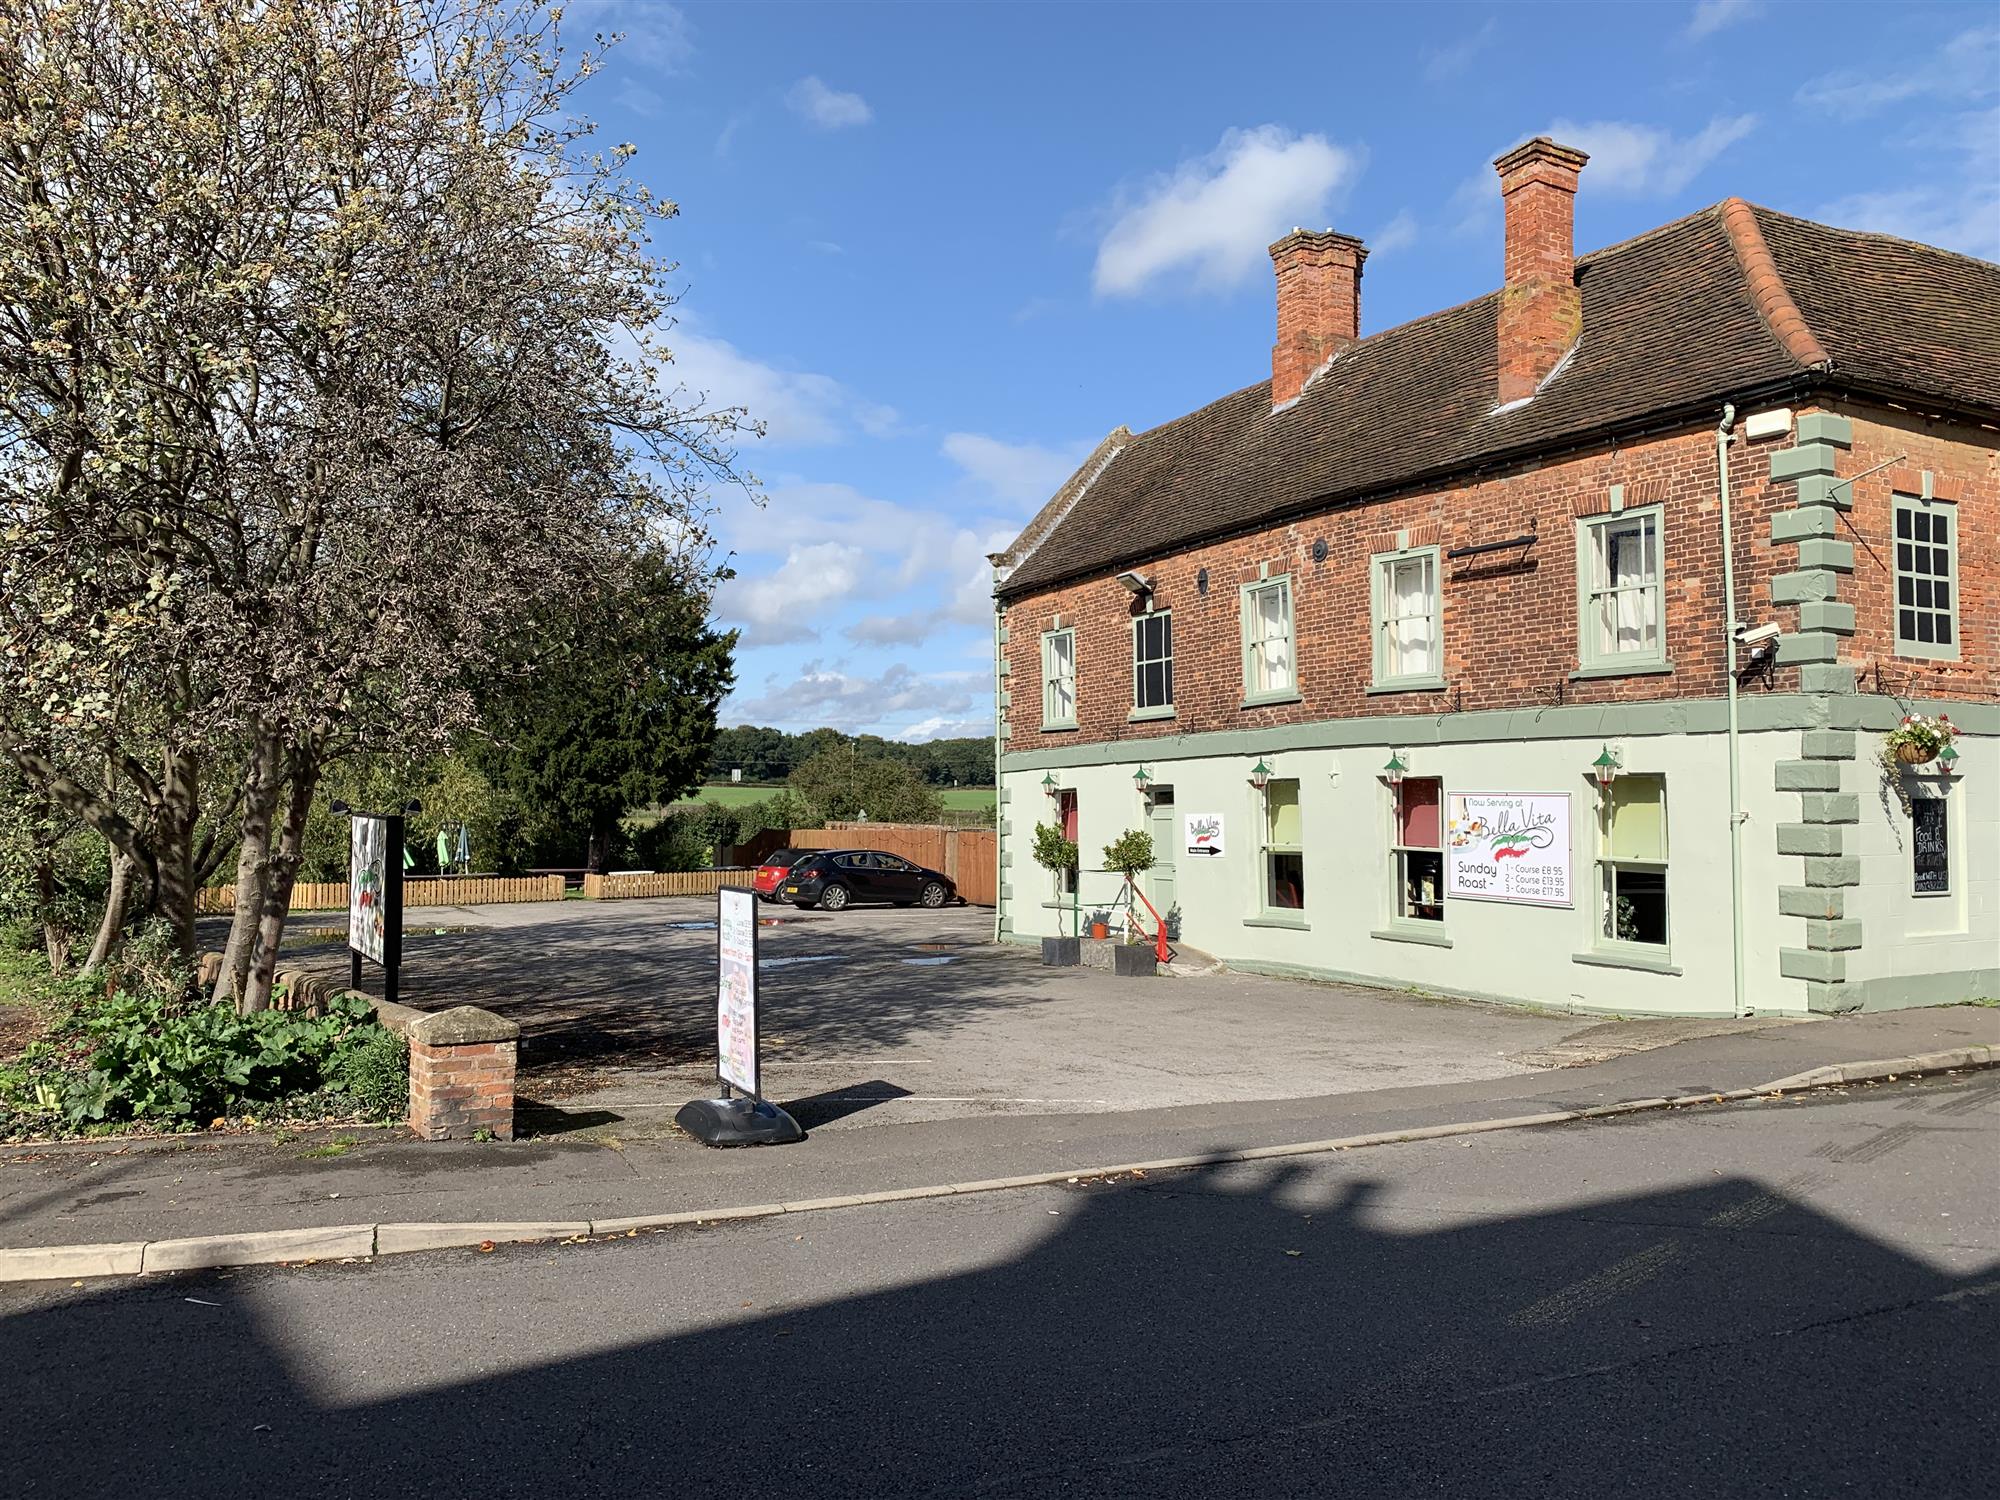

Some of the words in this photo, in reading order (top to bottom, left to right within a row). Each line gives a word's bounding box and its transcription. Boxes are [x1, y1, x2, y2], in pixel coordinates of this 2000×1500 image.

[1487, 798, 1513, 808] Serving
[1515, 799, 1523, 807] at
[1478, 810, 1520, 839] Bella
[1521, 802, 1556, 828] Vita
[1189, 820, 1208, 835] Bella
[1915, 826, 1932, 841] Food
[1917, 840, 1944, 854] DRINKS
[1458, 861, 1497, 878] Sunday
[1505, 864, 1509, 872] 1
[1515, 864, 1540, 874] Course
[1541, 866, 1563, 875] £8.95
[1458, 876, 1487, 889] Roast
[1505, 873, 1510, 882] 2
[1515, 874, 1540, 885] Course
[1505, 885, 1510, 893] 3
[1515, 885, 1541, 895] Course
[1542, 887, 1565, 897] £17.95
